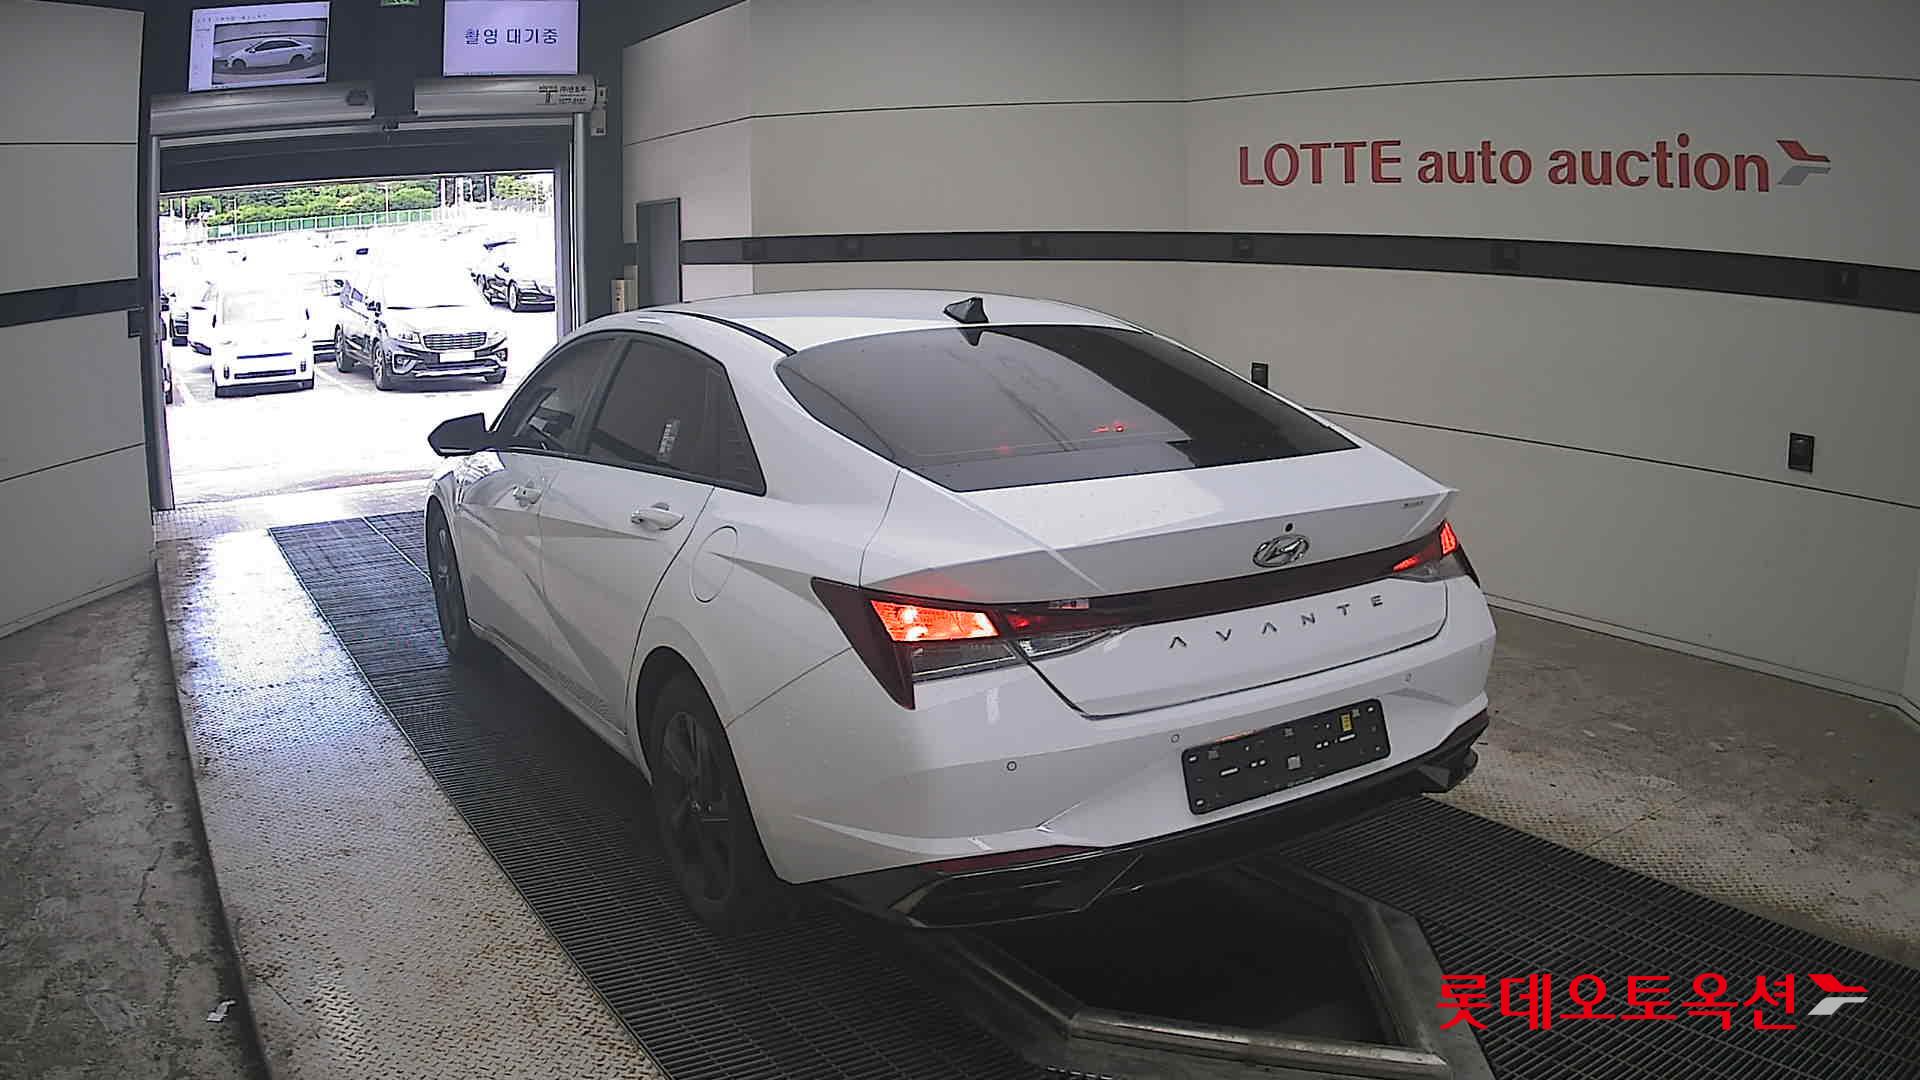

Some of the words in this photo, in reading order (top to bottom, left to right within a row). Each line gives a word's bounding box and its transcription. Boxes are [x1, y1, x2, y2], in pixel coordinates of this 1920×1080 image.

[506, 28, 559, 45] 대기중
[1239, 139, 1402, 186] LOTTE
[1417, 140, 1533, 185] auto
[1548, 133, 1770, 192] auction
[1167, 594, 1384, 650] AVANTE
